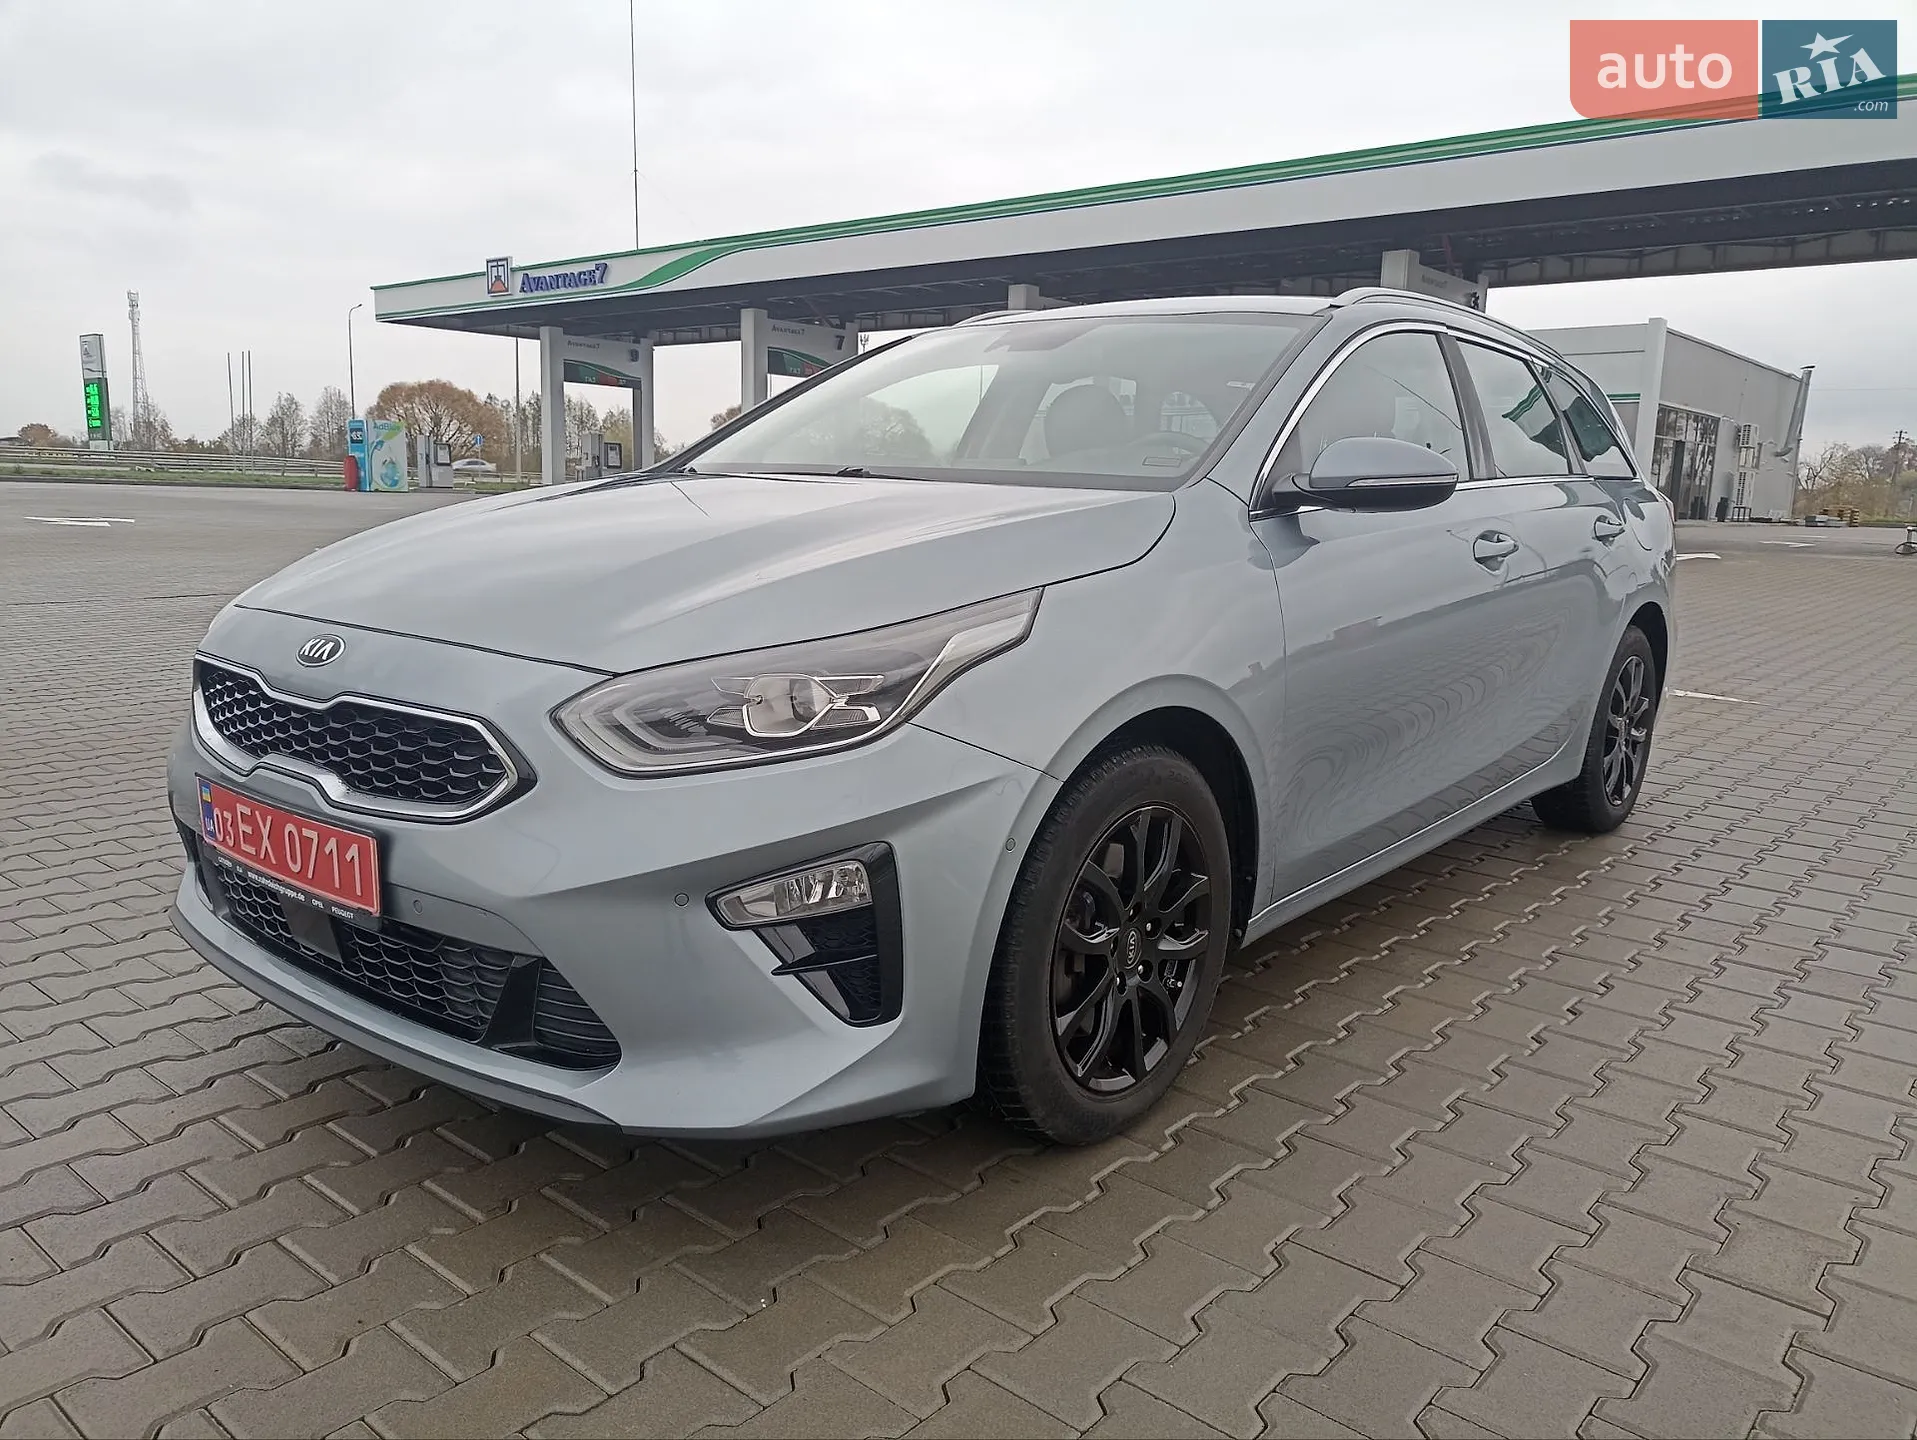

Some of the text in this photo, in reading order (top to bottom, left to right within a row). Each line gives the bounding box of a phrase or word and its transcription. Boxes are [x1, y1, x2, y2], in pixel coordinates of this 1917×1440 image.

[835, 335, 845, 350] 7
[300, 638, 335, 660] KIA
[284, 823, 362, 896] 0711
